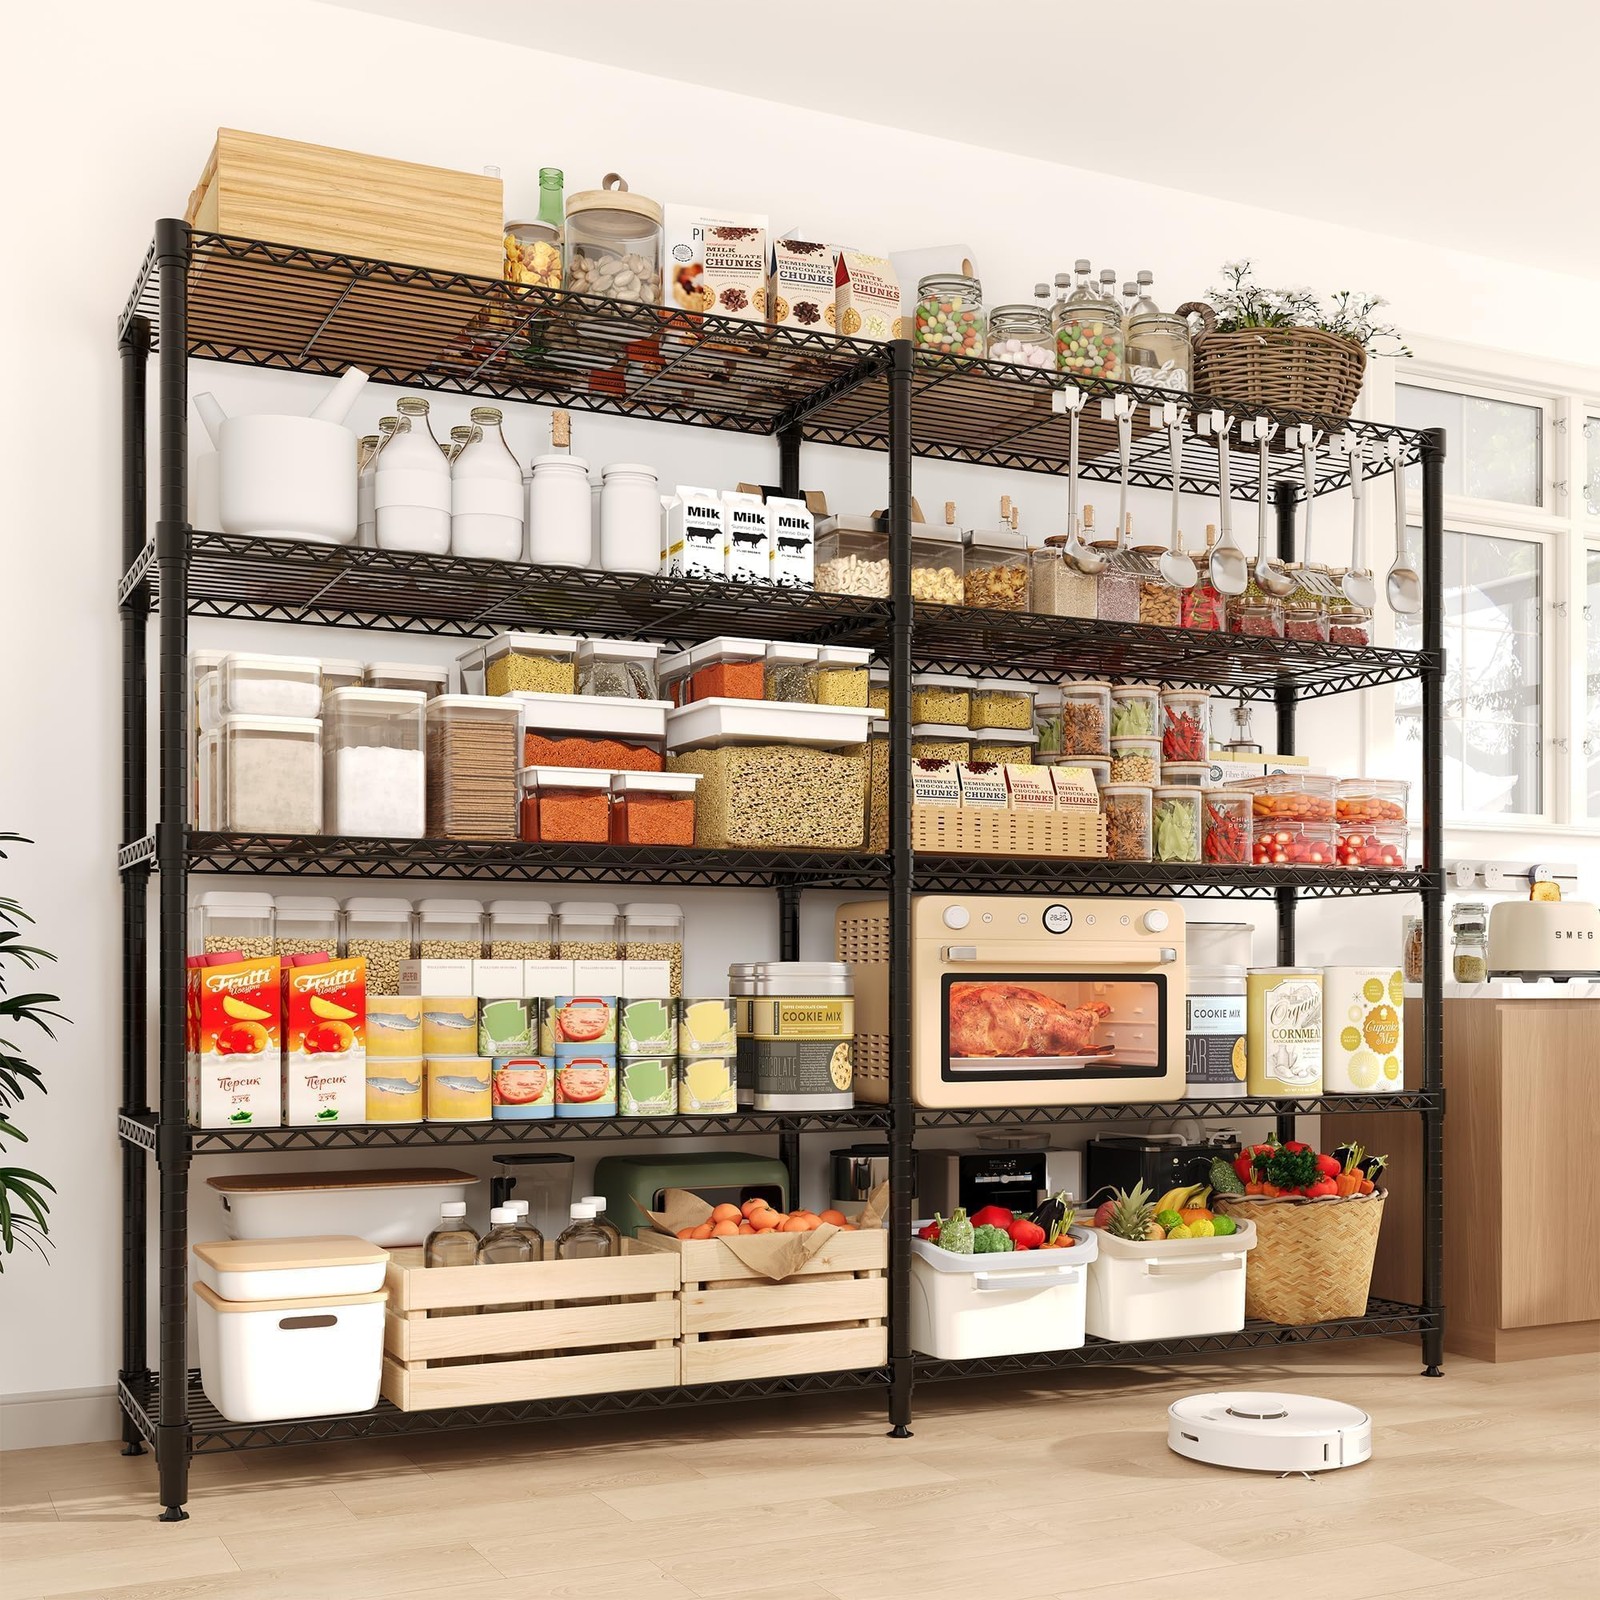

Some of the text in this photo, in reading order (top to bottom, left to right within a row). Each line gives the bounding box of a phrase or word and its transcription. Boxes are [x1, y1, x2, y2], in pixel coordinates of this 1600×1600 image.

[705, 252, 762, 260] CHOCOLATE
[705, 258, 762, 268] CHUNKS
[779, 260, 833, 270] SEMISWEET
[779, 264, 833, 275] CHOCOLATE
[780, 270, 834, 284] CHUNKS
[850, 271, 883, 283] WHITE
[851, 277, 900, 291] CHOCOLATE
[852, 282, 900, 299] CHUNKS
[687, 506, 720, 520] Milk
[733, 511, 766, 525] Milk
[779, 516, 810, 530] Milk
[916, 789, 959, 797] CHUNKS
[965, 791, 1007, 799] CHUNKS
[1014, 793, 1054, 802] CHUNKS
[1059, 796, 1099, 804] CHUNKS
[1555, 931, 1594, 940] SMEG
[206, 969, 272, 993] Frutti
[294, 969, 357, 993] Frutti
[1193, 1009, 1241, 1019] COOKIE MIX
[1270, 991, 1320, 1028] Organi
[782, 1011, 842, 1022] COOKIE MIX
[1375, 1032, 1396, 1045] Mix
[217, 1077, 261, 1093] Персик
[305, 1075, 347, 1091] Персик
